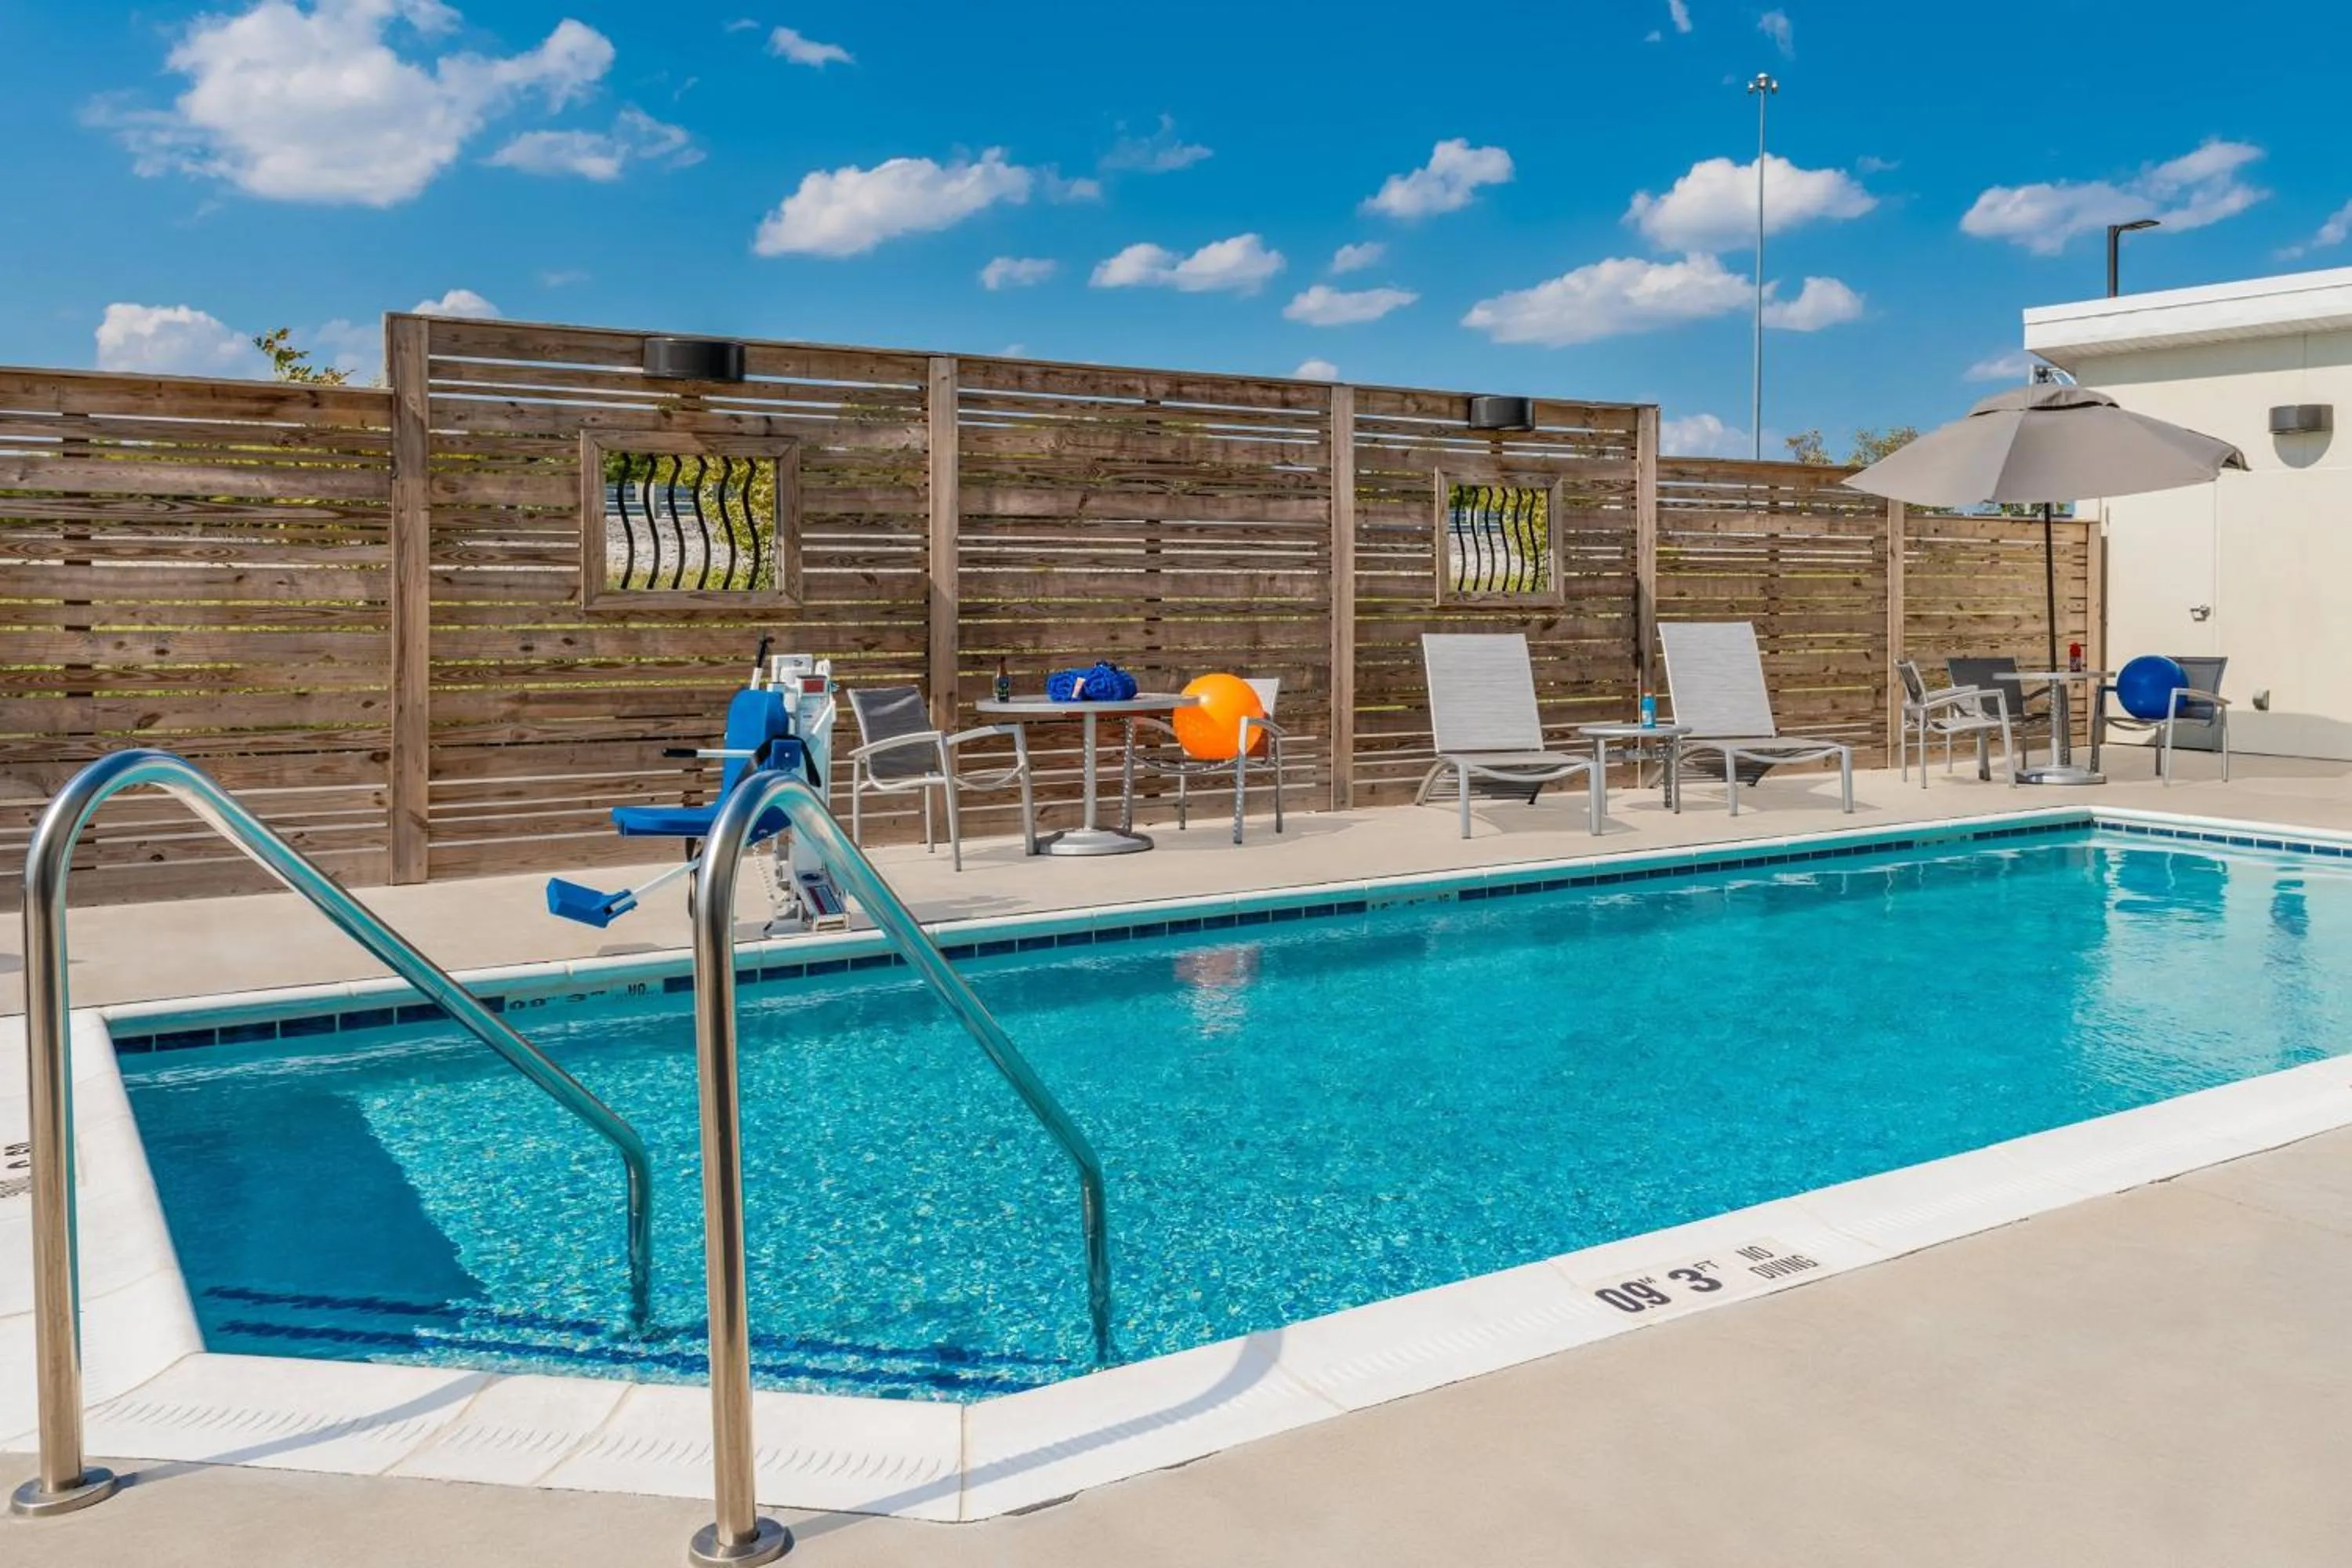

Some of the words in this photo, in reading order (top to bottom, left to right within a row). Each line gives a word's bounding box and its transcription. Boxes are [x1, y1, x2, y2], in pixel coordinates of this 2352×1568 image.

[1735, 1246, 1774, 1261] NO
[1748, 1254, 1820, 1279] DIVING
[1667, 1268, 1723, 1293] 3
